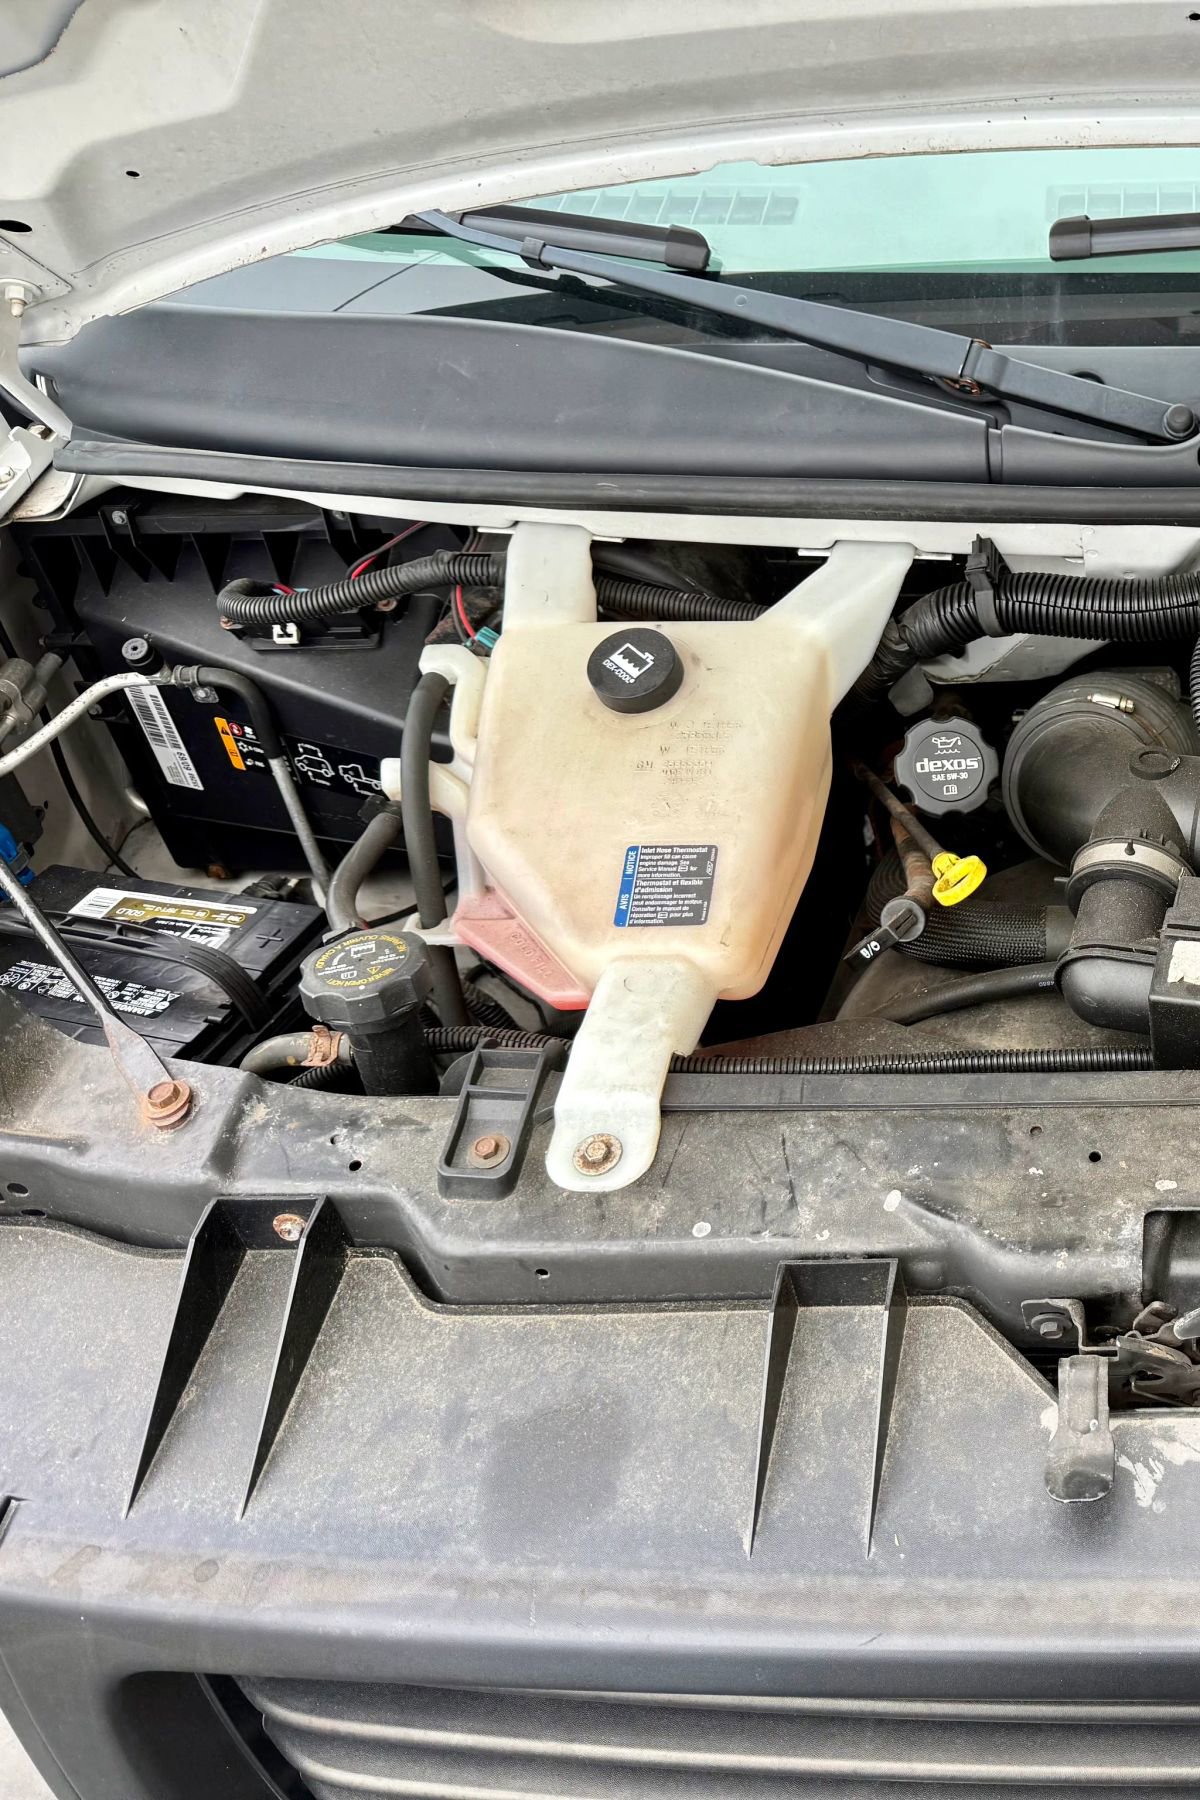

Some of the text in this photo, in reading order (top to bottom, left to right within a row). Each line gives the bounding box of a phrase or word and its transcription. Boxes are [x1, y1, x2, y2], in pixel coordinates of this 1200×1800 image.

[916, 758, 979, 773] dexos
[931, 772, 969, 782] SAE 5W-30
[625, 850, 637, 875] NOTICE
[619, 893, 630, 910] AVIS
[116, 907, 145, 917] GOLD
